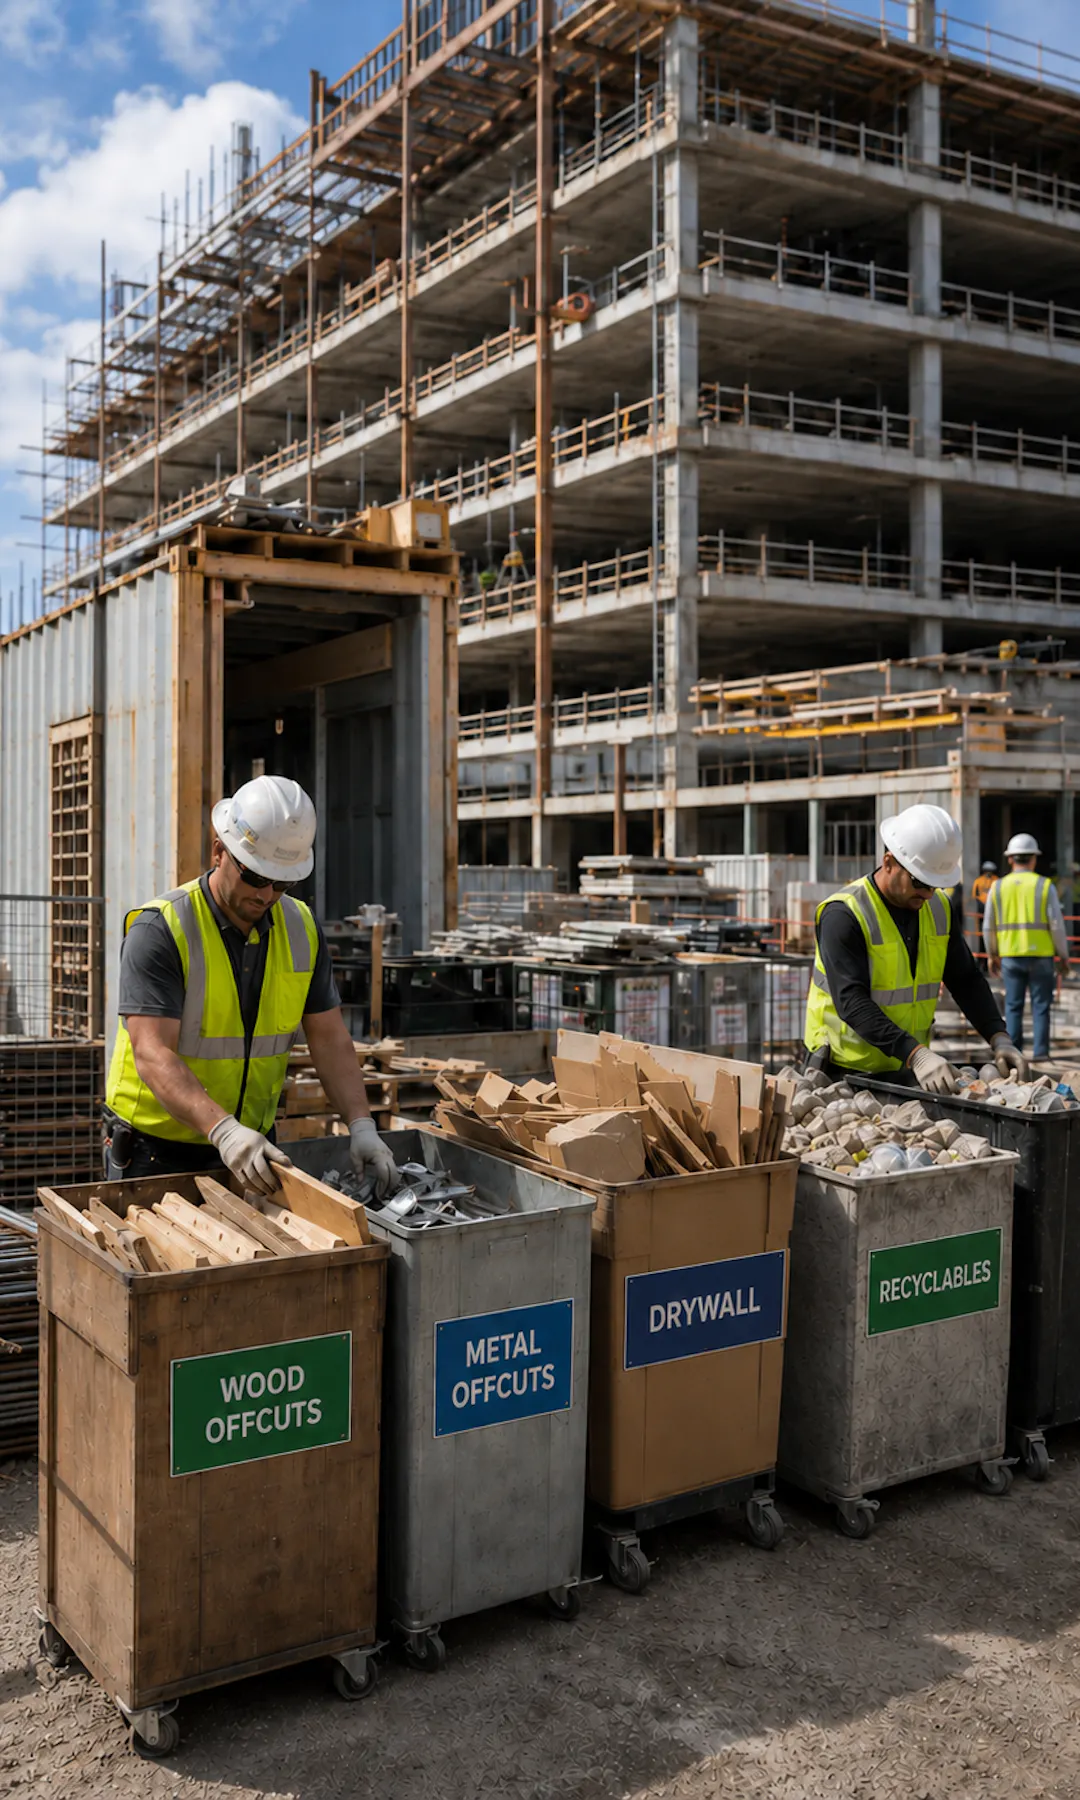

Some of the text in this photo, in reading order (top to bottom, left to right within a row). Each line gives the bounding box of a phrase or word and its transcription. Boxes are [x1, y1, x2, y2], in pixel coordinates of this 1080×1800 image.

[879, 1259, 992, 1304] RECYCLABLES
[649, 1286, 761, 1333] DRYWALL
[465, 1329, 542, 1368] METAL
[219, 1365, 305, 1403] WOOD
[451, 1363, 556, 1409] OFFCUTS
[205, 1397, 323, 1444] OFFCUTS
